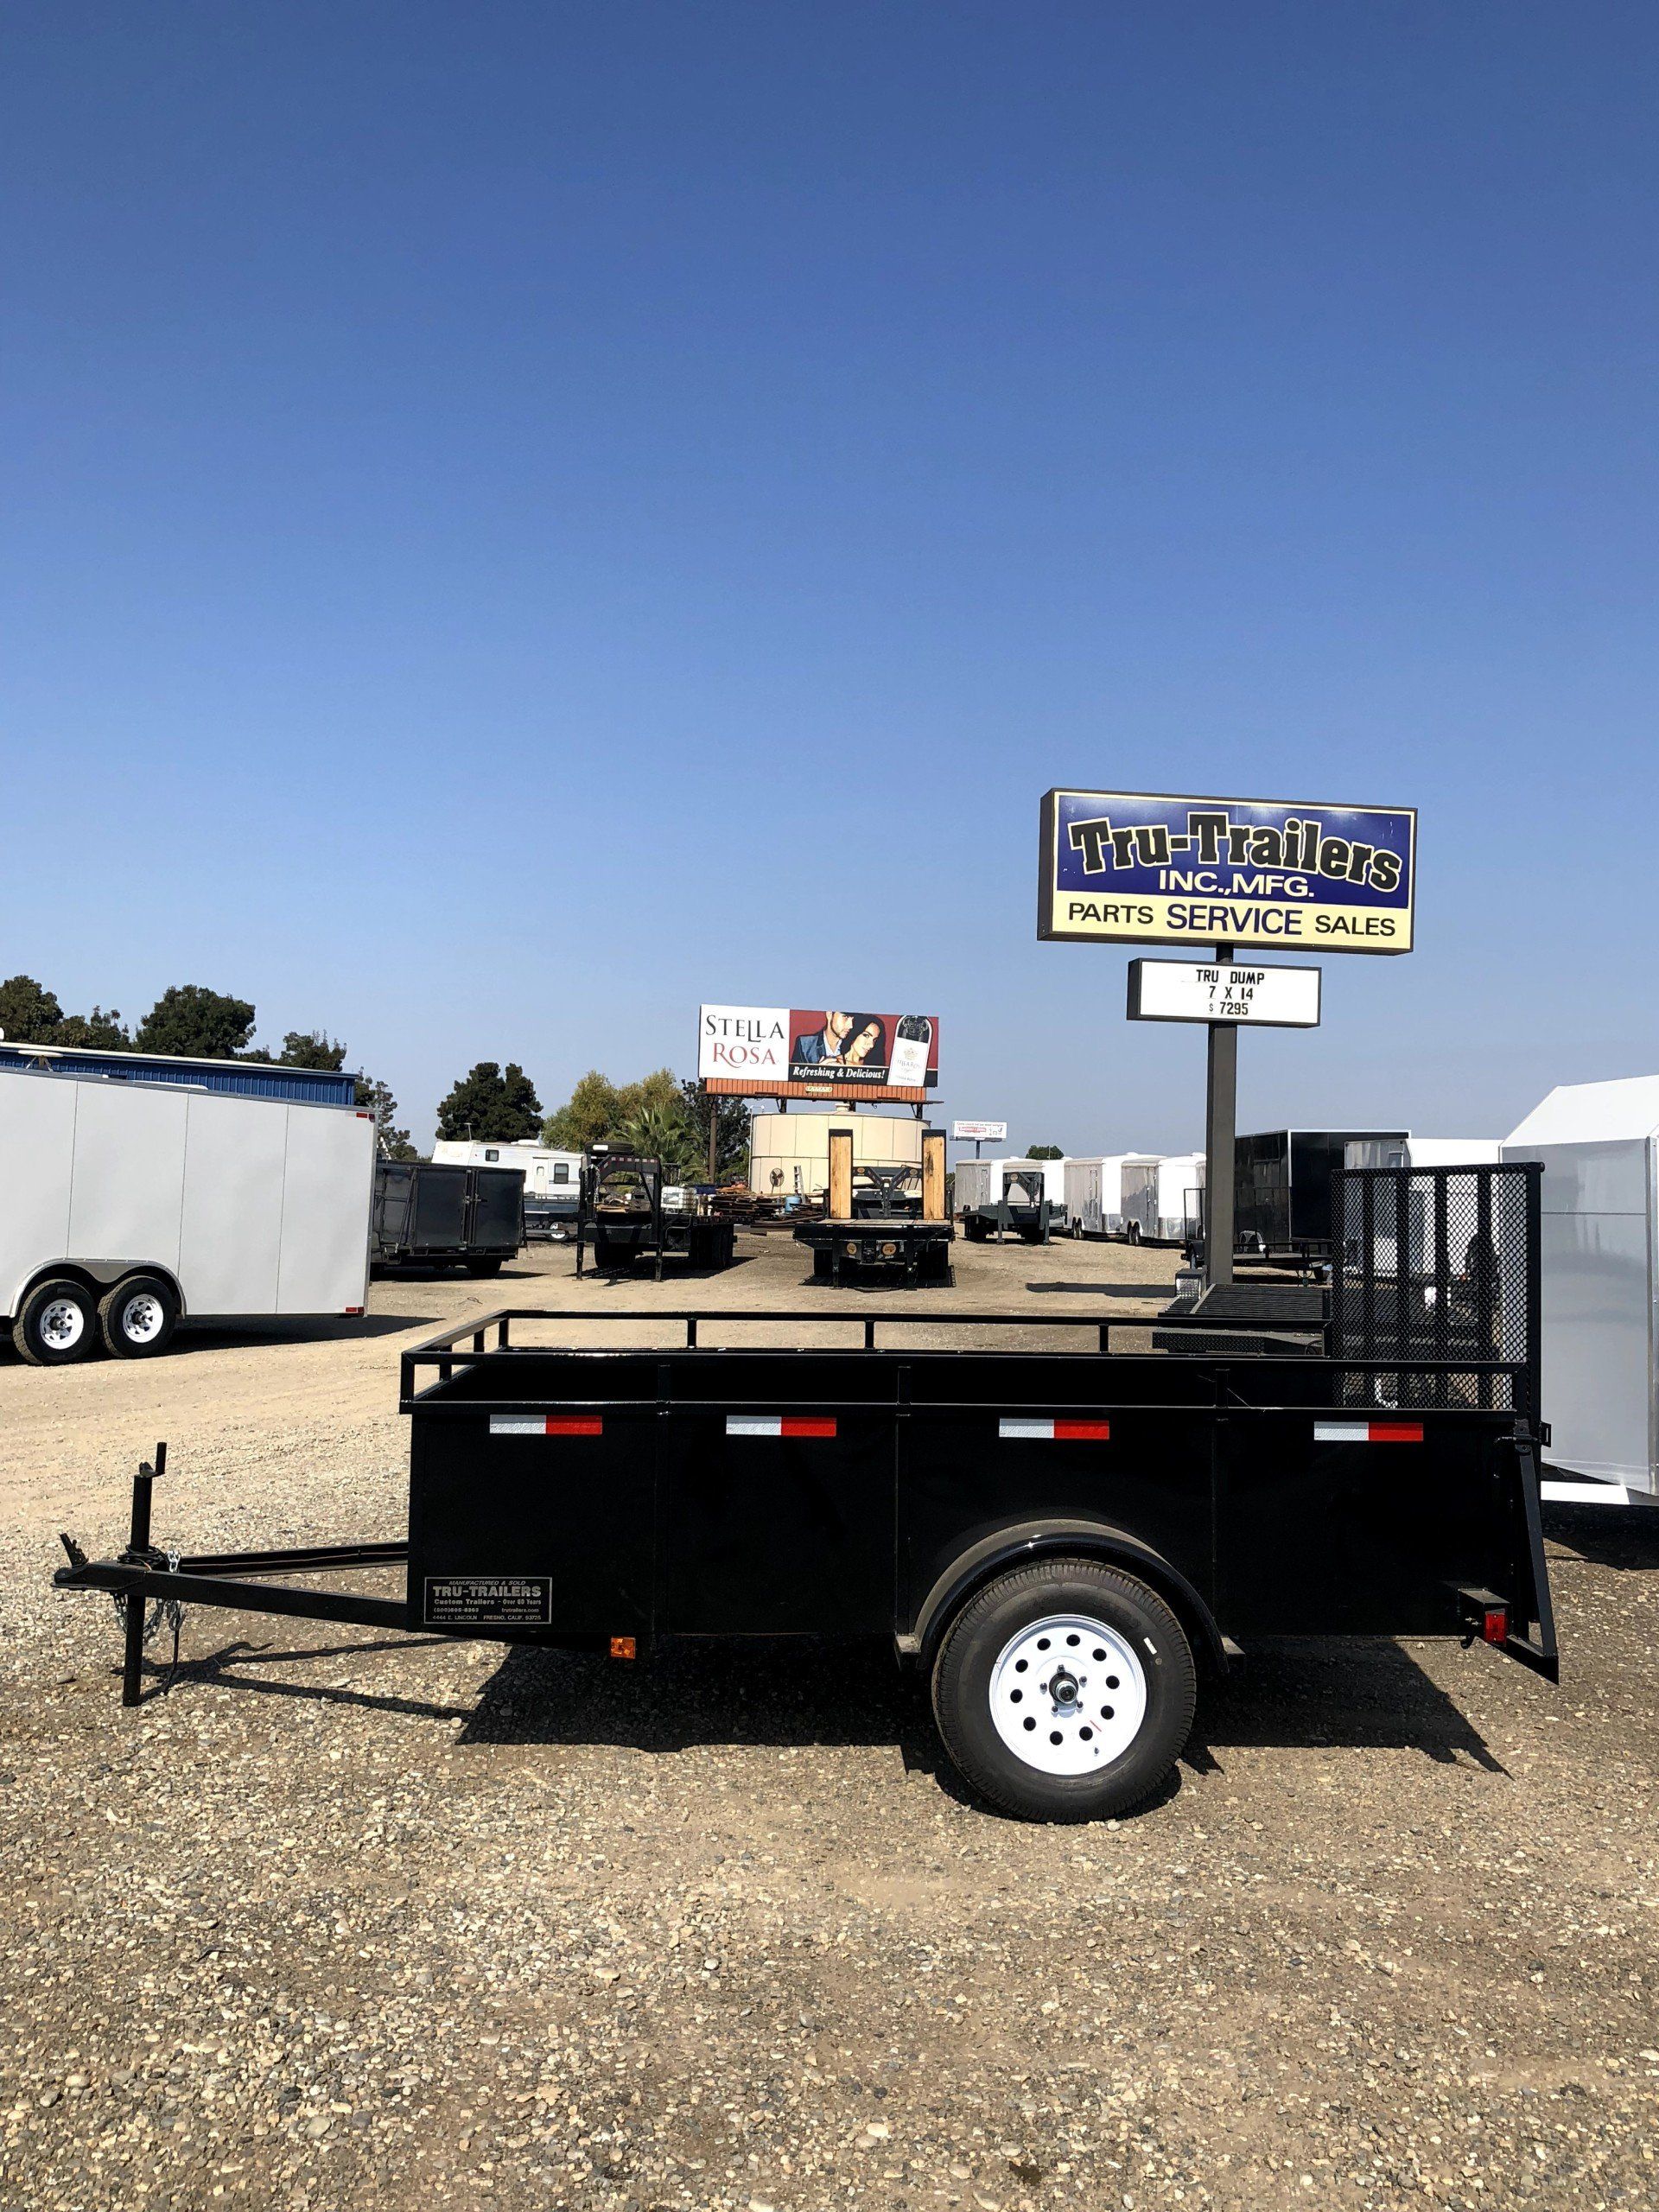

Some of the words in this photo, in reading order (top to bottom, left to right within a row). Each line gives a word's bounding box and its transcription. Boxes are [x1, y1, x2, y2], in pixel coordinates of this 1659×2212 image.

[1068, 811, 1403, 893] Tru-Trailers
[1068, 902, 1154, 925] PARTS
[1166, 903, 1303, 936] SERVICE
[1315, 914, 1395, 937] SALES
[1196, 969, 1219, 984] TRU
[1230, 970, 1265, 986] DUMP
[1208, 985, 1216, 999] 7
[1224, 987, 1232, 1000] X
[1240, 987, 1254, 1001] 14
[1219, 1001, 1249, 1015] 7295
[705, 1014, 785, 1043] STELLA
[713, 1042, 776, 1068] ROSA
[792, 1066, 836, 1081] Refreshing
[836, 1068, 844, 1078] &
[846, 1068, 886, 1079] Delicious!
[433, 1586, 542, 1597] TRU-TRAILERS
